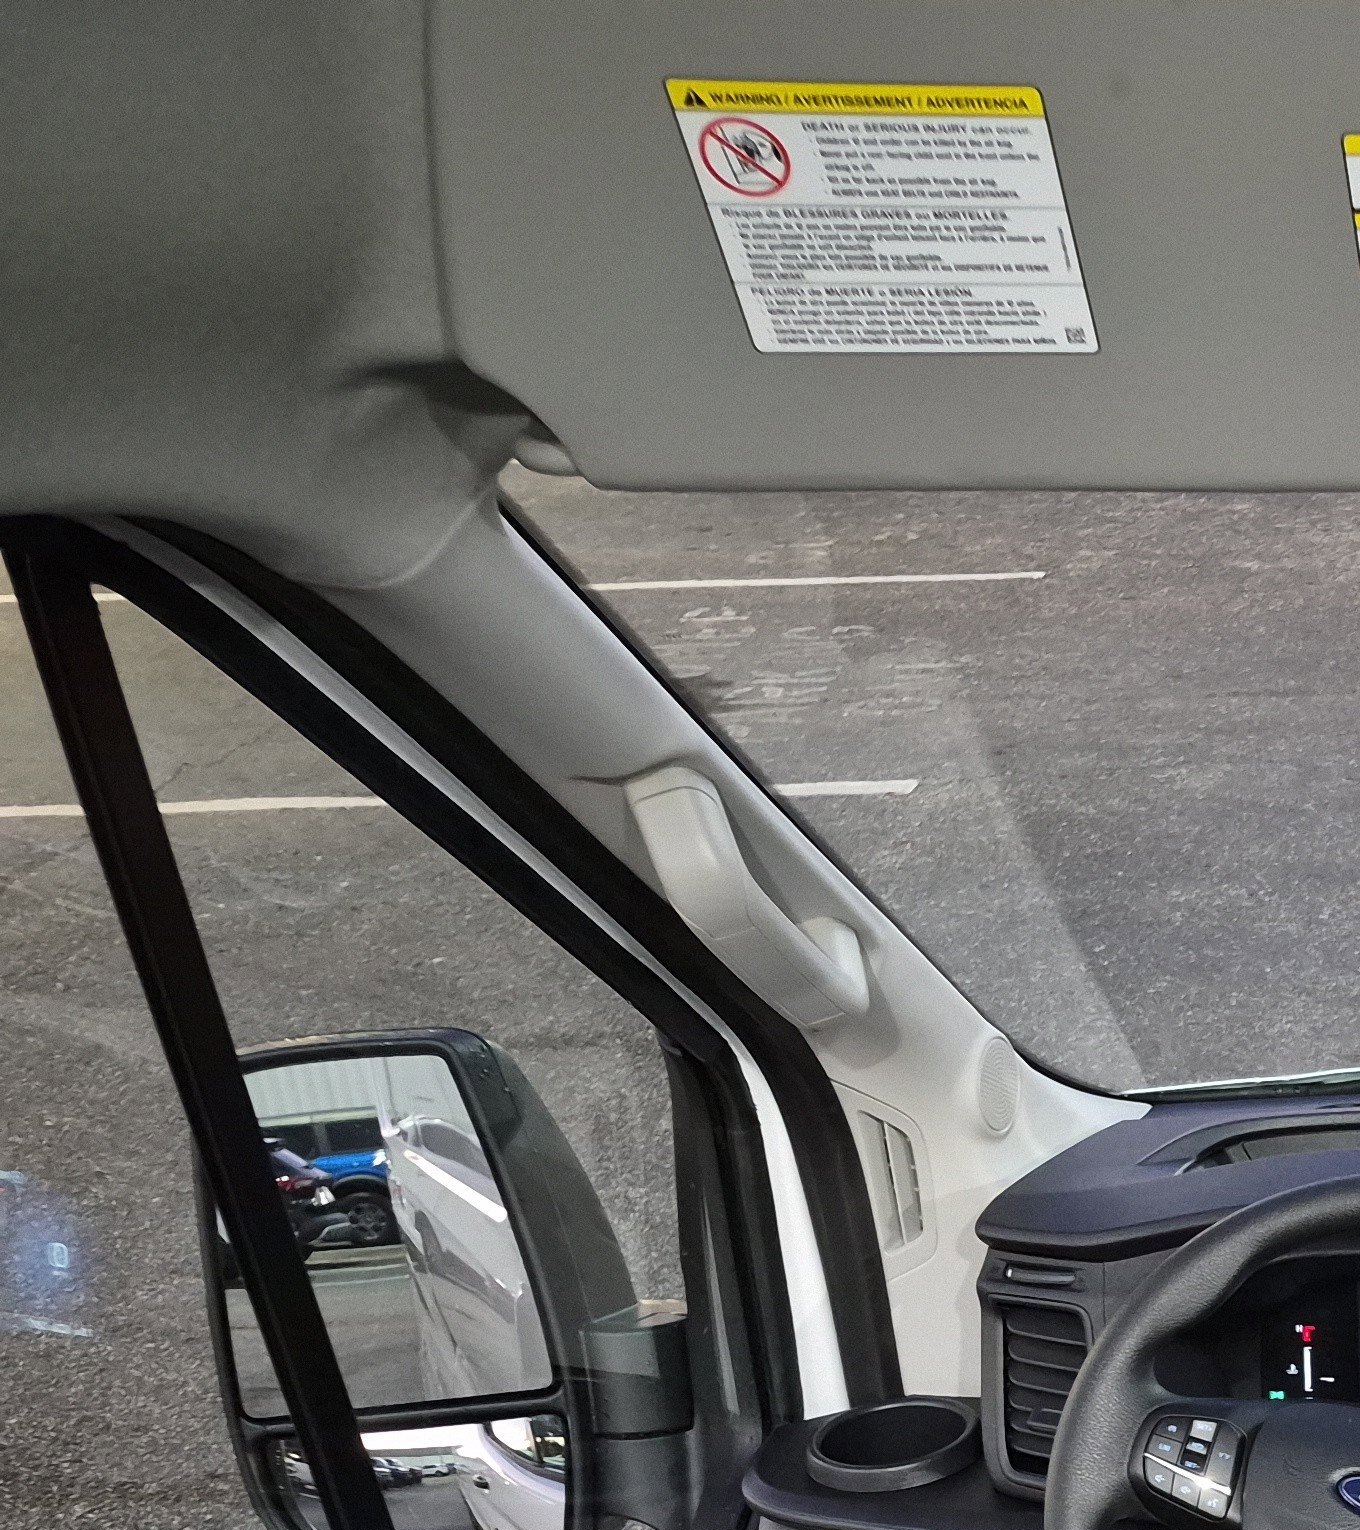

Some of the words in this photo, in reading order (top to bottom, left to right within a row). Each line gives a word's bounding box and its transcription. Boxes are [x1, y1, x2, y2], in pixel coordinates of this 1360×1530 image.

[709, 92, 782, 106] WARNING
[793, 94, 914, 108] AVERTISSEMENT
[926, 97, 1030, 110] ADVERTENCIA
[922, 124, 967, 133] INJURY
